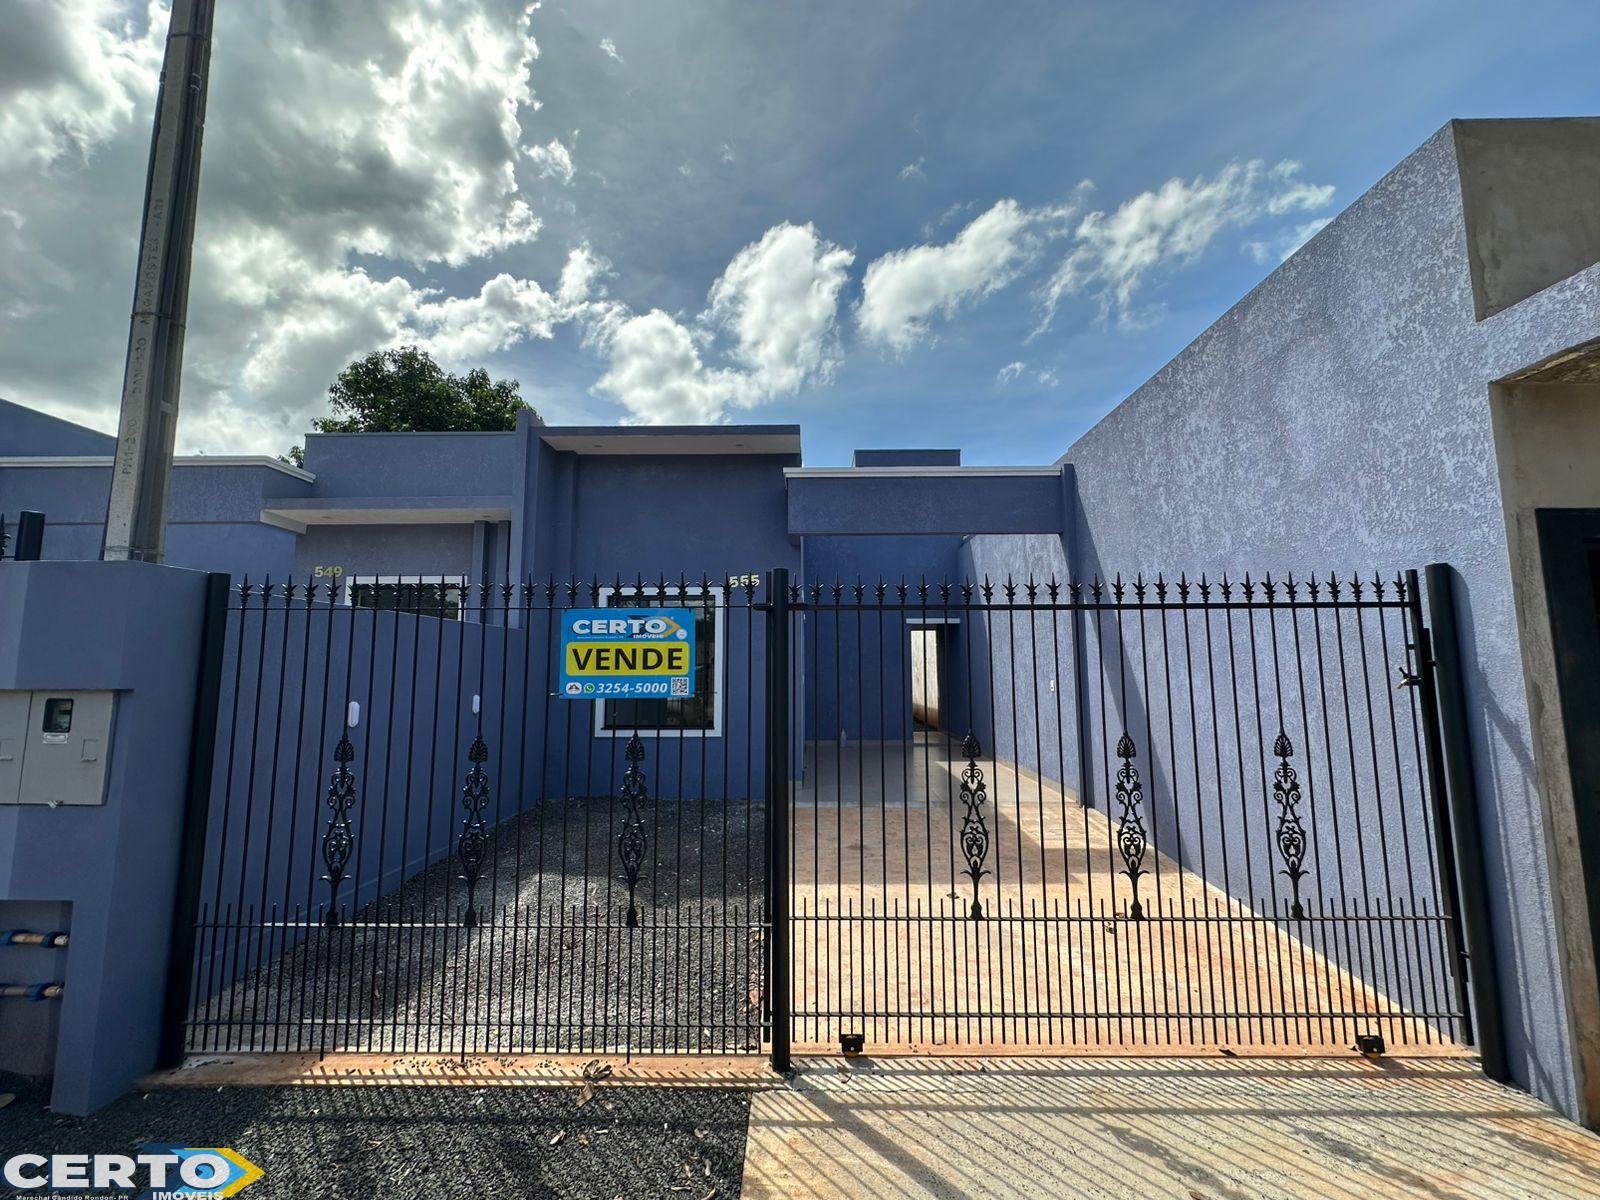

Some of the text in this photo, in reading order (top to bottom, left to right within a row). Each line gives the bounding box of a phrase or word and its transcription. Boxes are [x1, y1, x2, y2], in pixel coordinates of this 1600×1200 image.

[314, 566, 343, 578] 549
[729, 574, 760, 588] 555
[571, 618, 666, 635] CERTO
[572, 647, 683, 671] VENDE
[596, 682, 668, 694] 3254-5000
